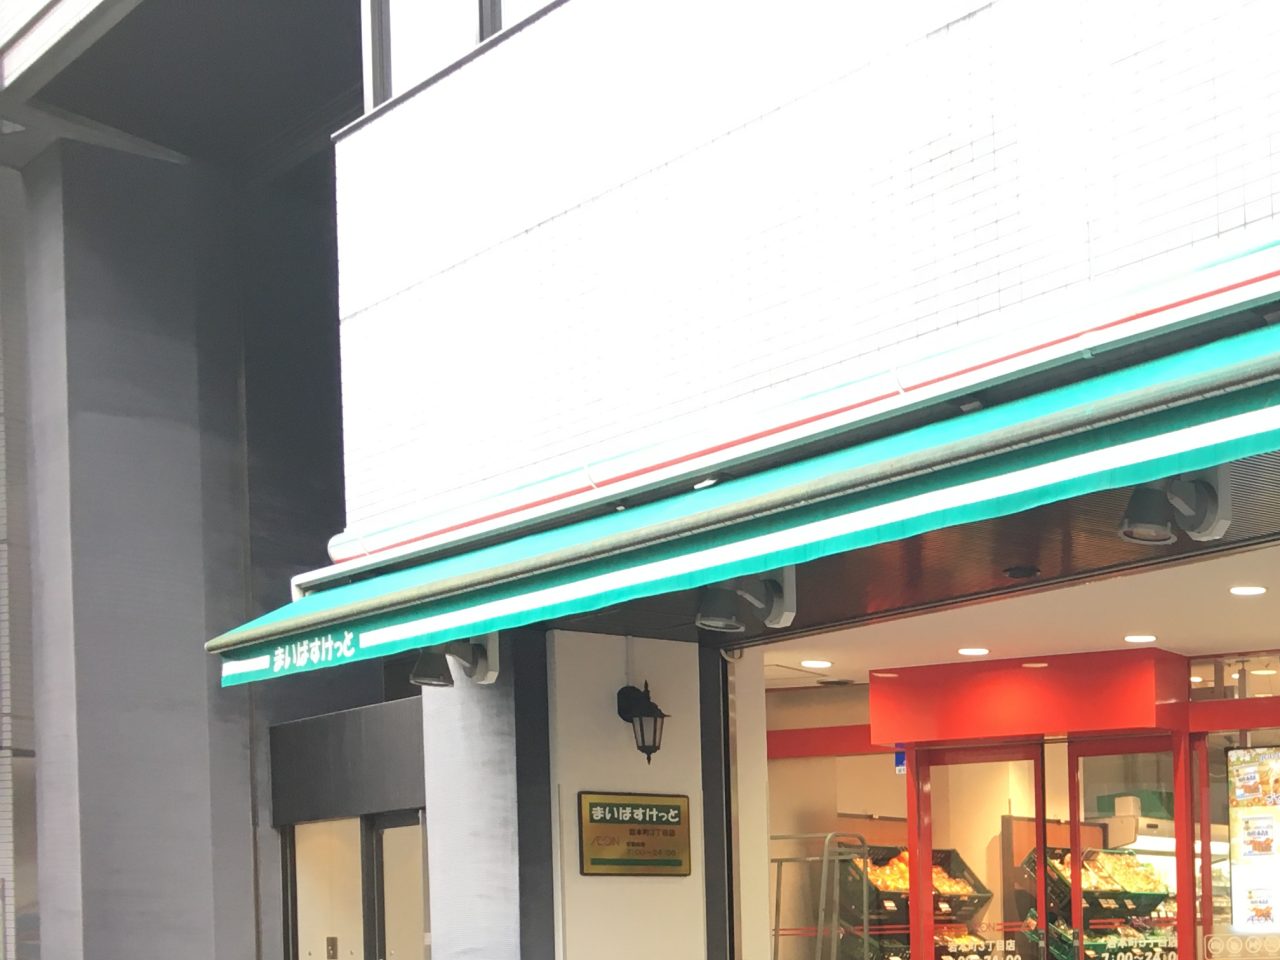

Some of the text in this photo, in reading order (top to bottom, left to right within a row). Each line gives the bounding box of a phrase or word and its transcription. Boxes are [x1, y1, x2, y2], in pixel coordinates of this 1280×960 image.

[273, 630, 356, 673] まいばすけっと
[591, 806, 680, 822] まいばすけっと
